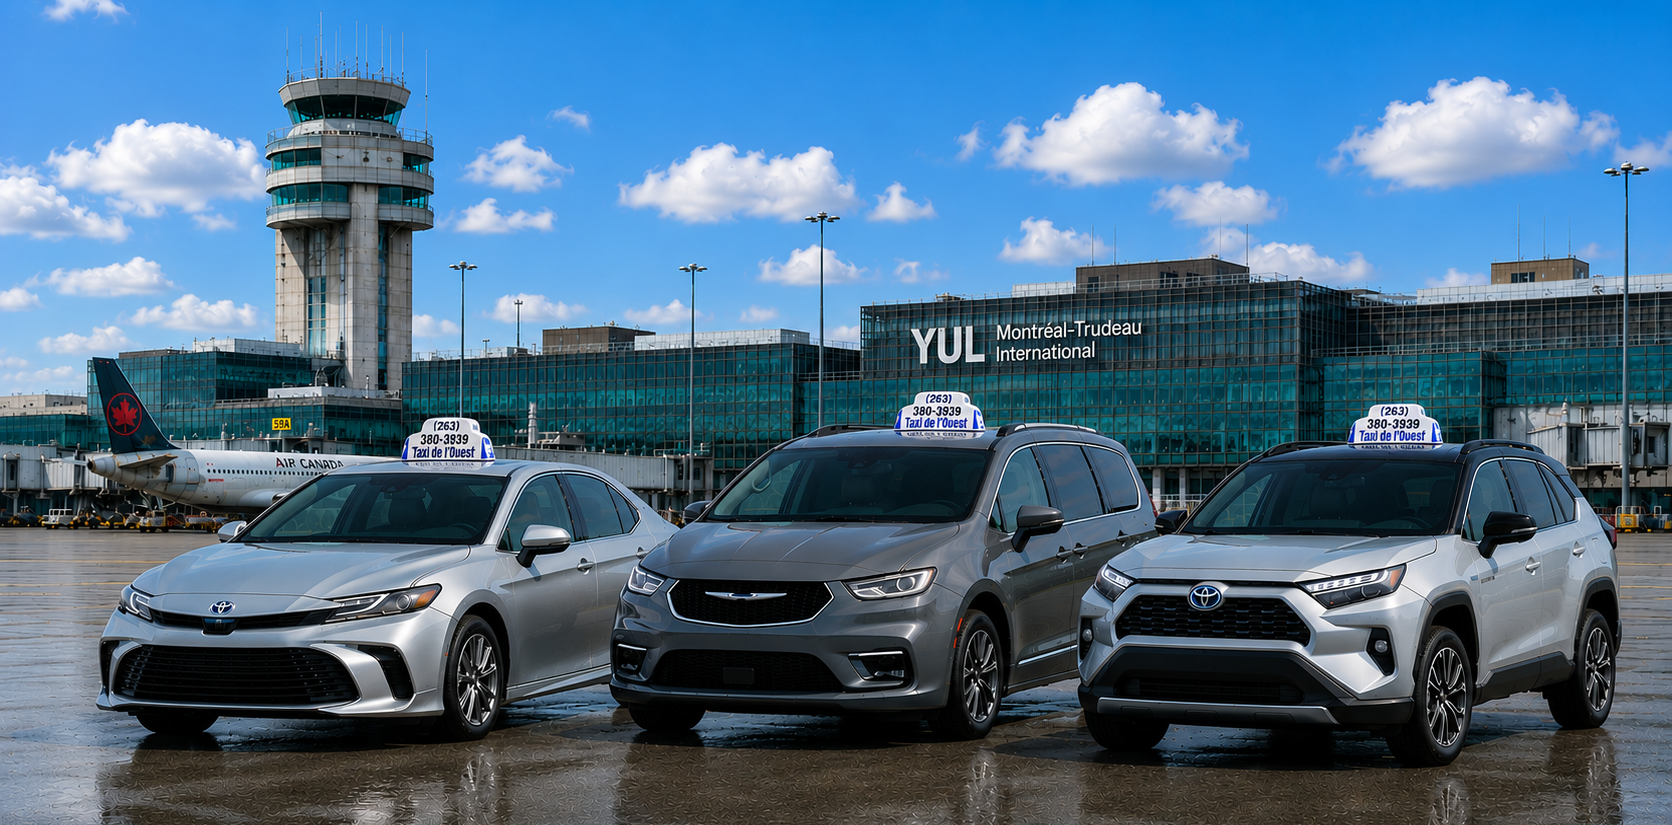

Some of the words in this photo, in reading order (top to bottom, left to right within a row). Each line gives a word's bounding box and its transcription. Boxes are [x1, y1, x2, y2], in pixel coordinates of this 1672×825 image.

[996, 319, 1142, 341] Montréal-Trudeau
[910, 325, 986, 365] YUL
[996, 340, 1096, 362] International
[925, 393, 952, 404] (263)
[913, 406, 961, 416] 380-3939
[1381, 406, 1409, 417] (263)
[433, 420, 460, 432] (263)
[924, 417, 935, 428] de
[1367, 418, 1420, 429] 380-3939
[420, 434, 469, 445] 380-3939
[1380, 430, 1392, 441] de
[412, 446, 430, 458] Taxi
[431, 446, 443, 458] de
[444, 446, 476, 458] l'Ouest
[276, 457, 296, 468] AIR
[299, 458, 344, 469] CANADA
